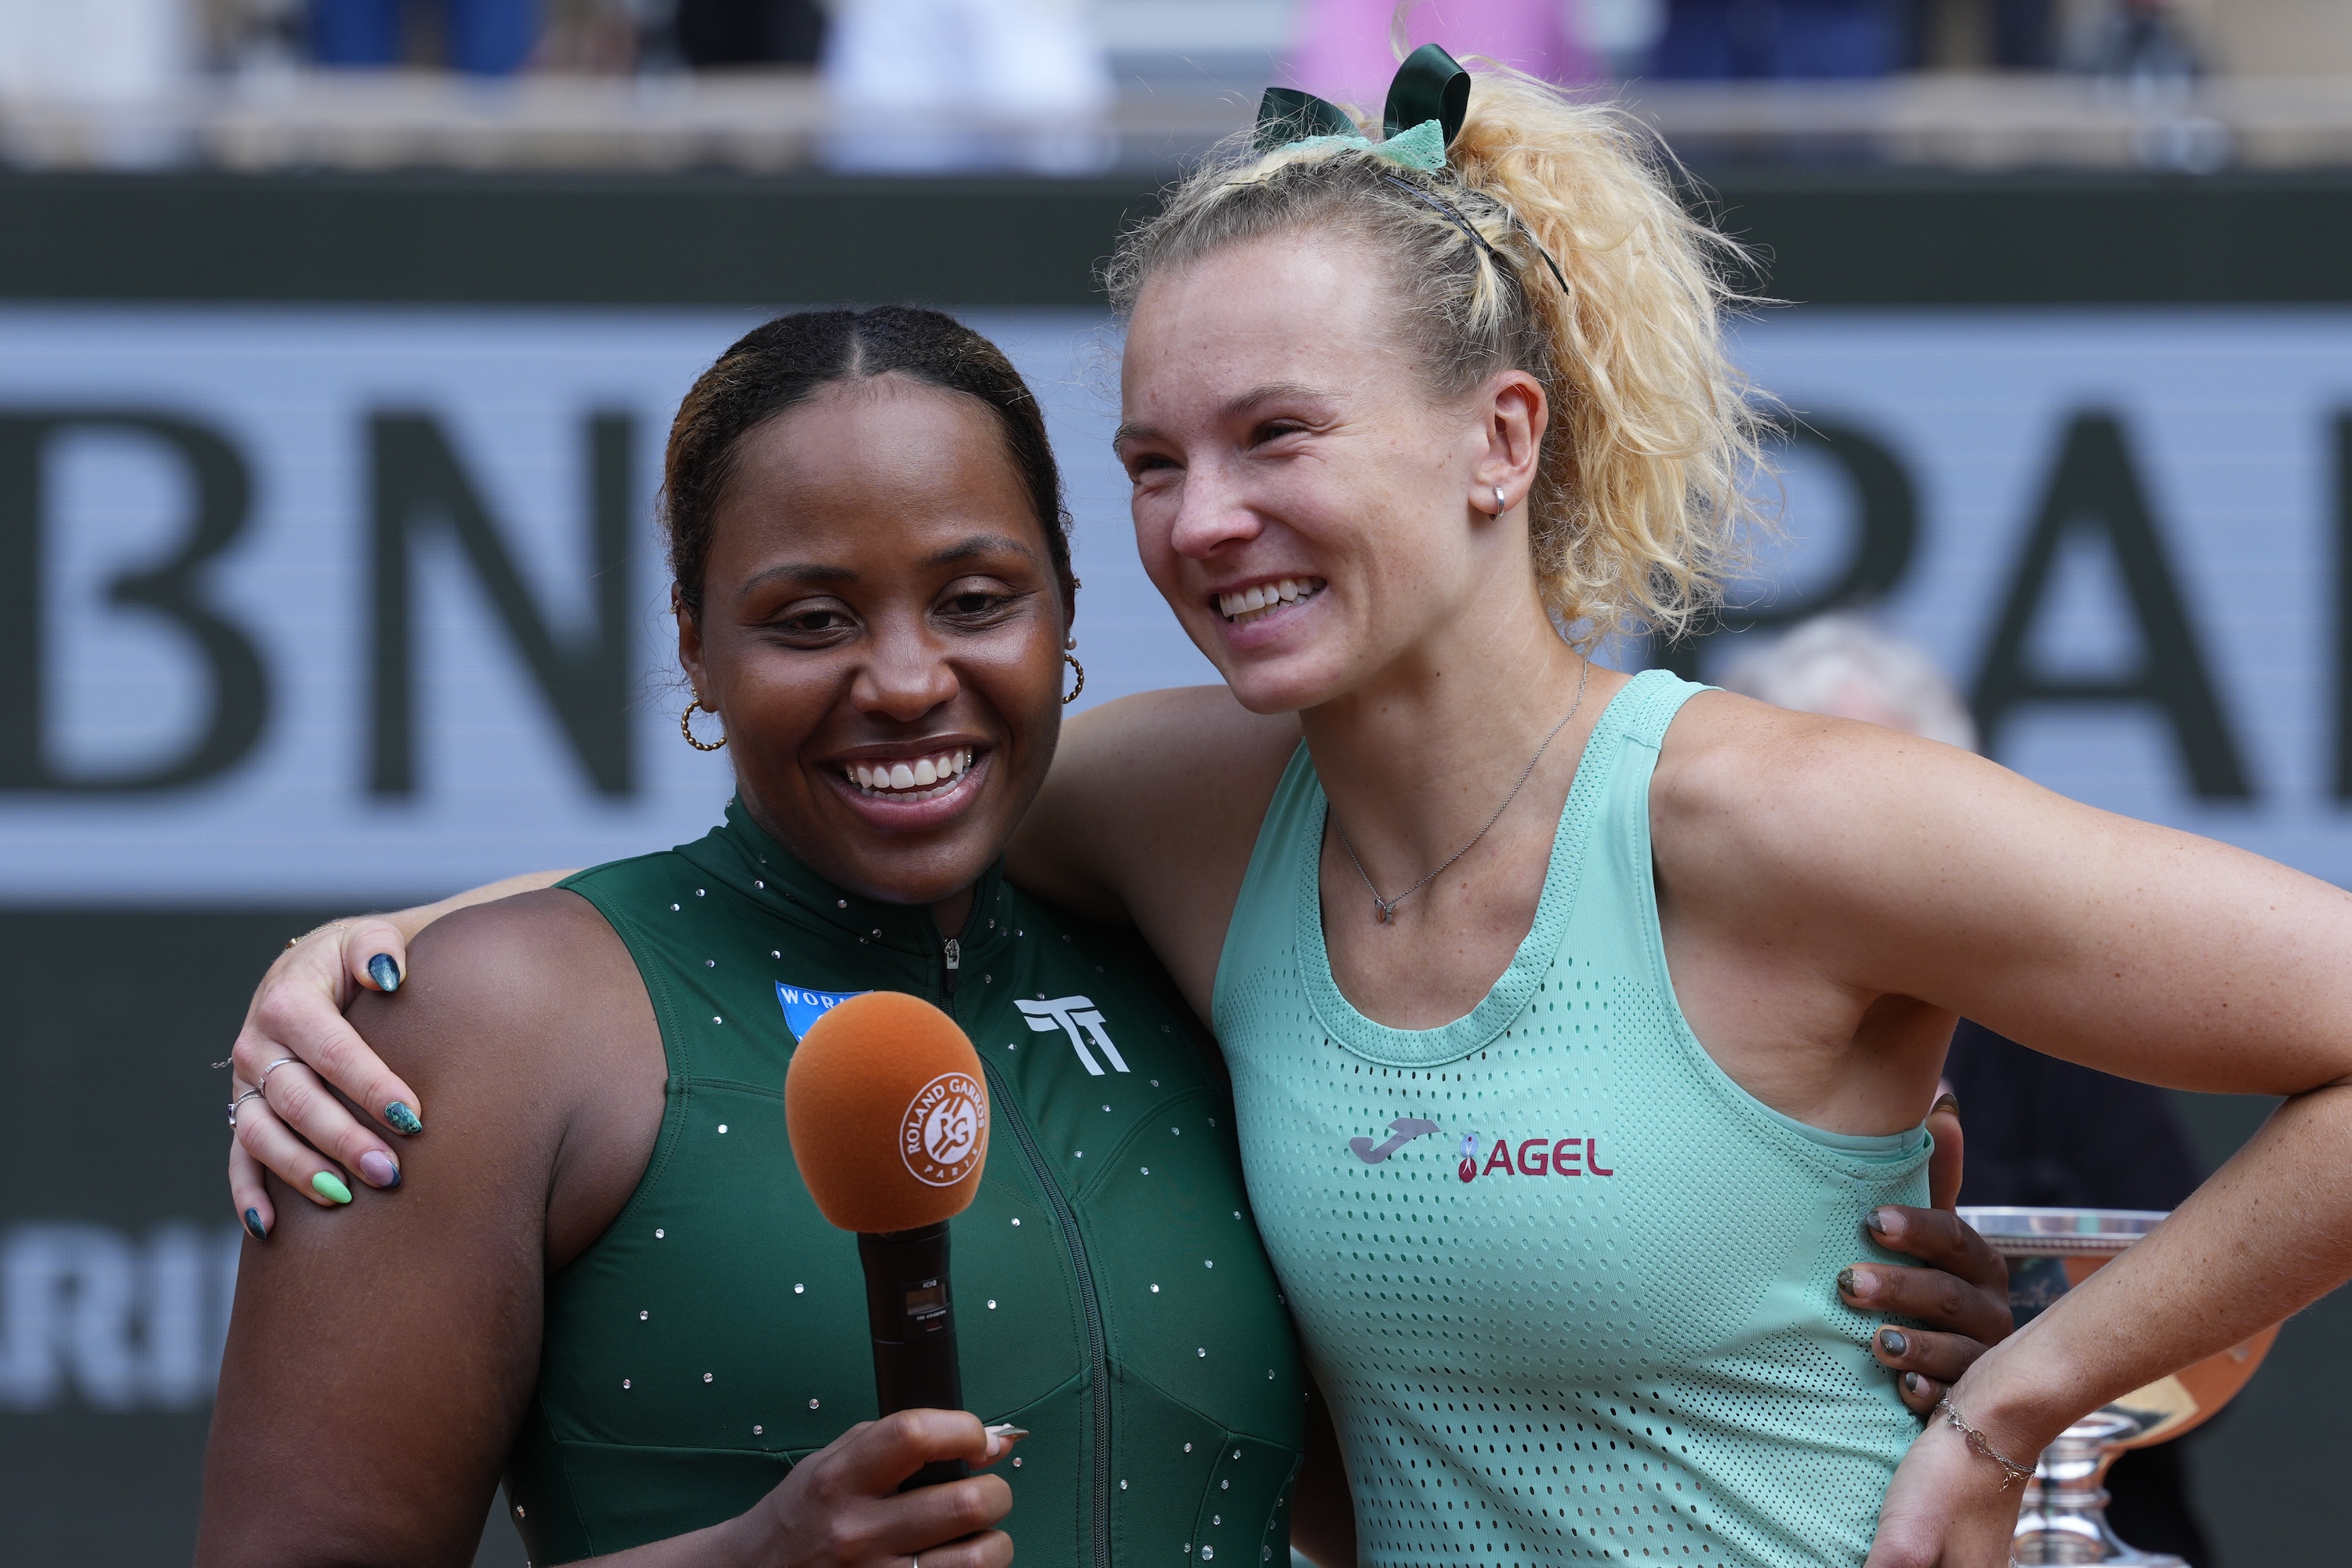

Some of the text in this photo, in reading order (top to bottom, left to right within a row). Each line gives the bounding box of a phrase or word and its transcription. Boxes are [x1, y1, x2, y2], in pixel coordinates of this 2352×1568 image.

[1653, 398, 2352, 808] PA
[906, 1079, 985, 1154] ROLAND GARROS
[924, 1148, 978, 1179] PARIS
[1483, 1138, 1613, 1177] AGEL
[0, 1221, 245, 1408] RI
